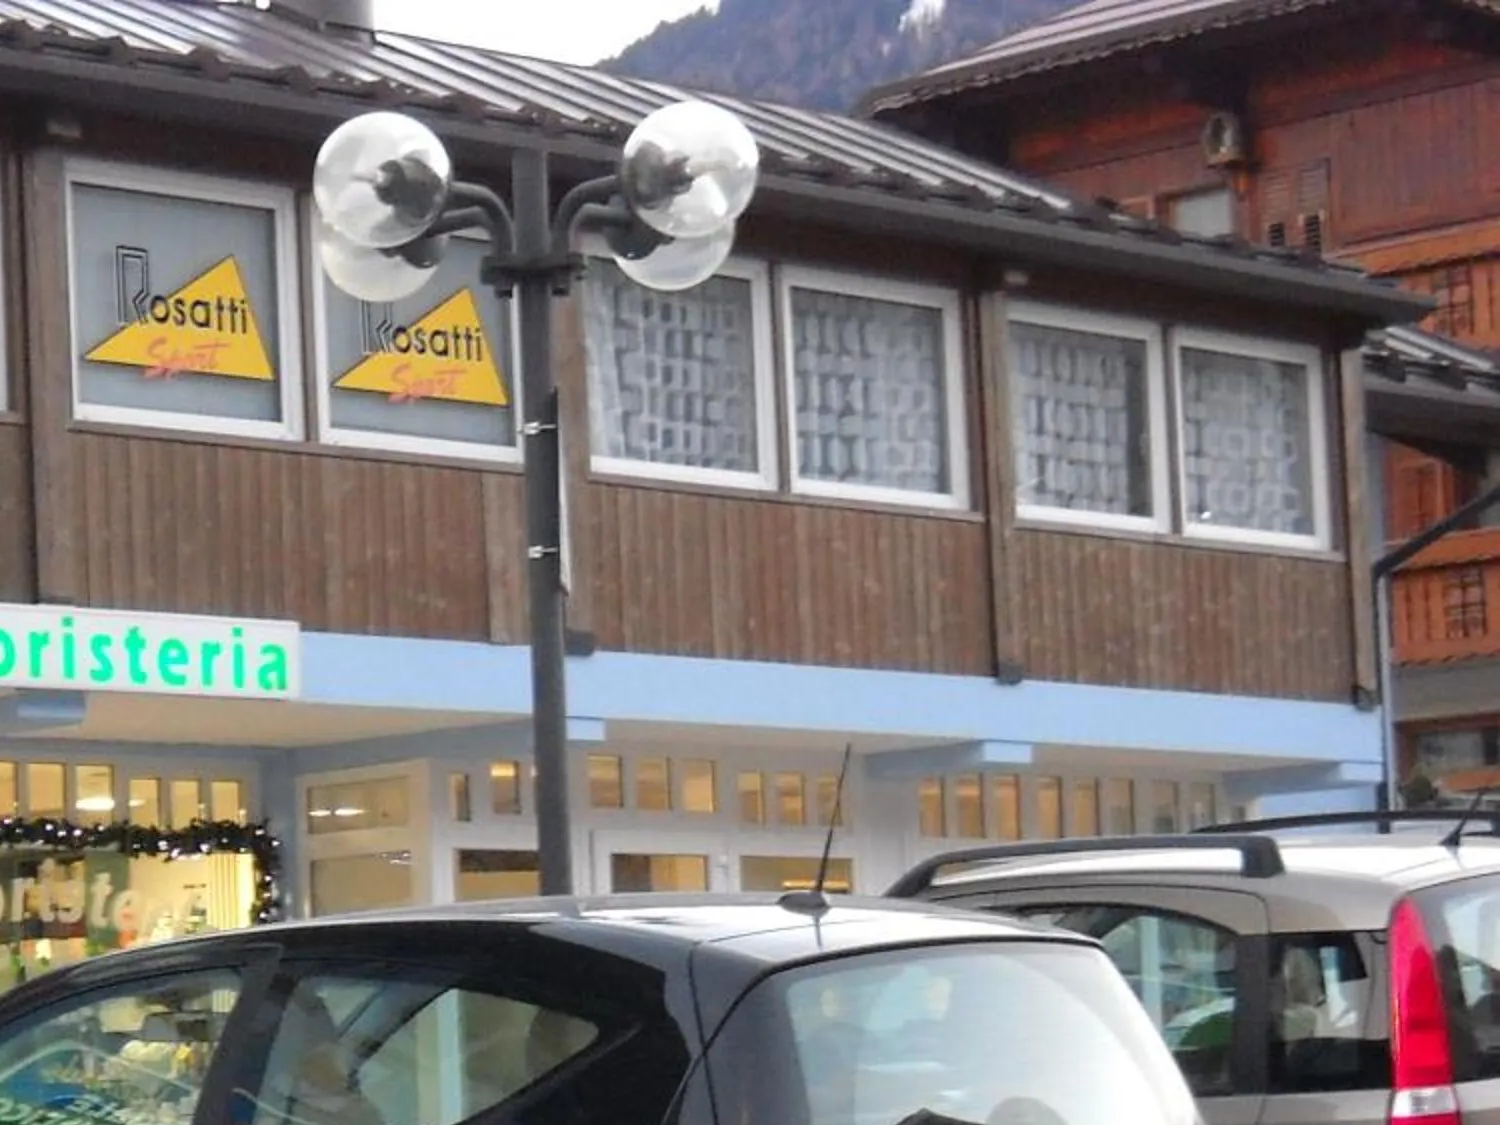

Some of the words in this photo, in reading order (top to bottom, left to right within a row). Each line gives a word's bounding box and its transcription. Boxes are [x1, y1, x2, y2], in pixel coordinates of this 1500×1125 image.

[115, 245, 248, 335] Rosatti
[143, 336, 232, 381] Sport
[360, 300, 483, 362] Rosatti
